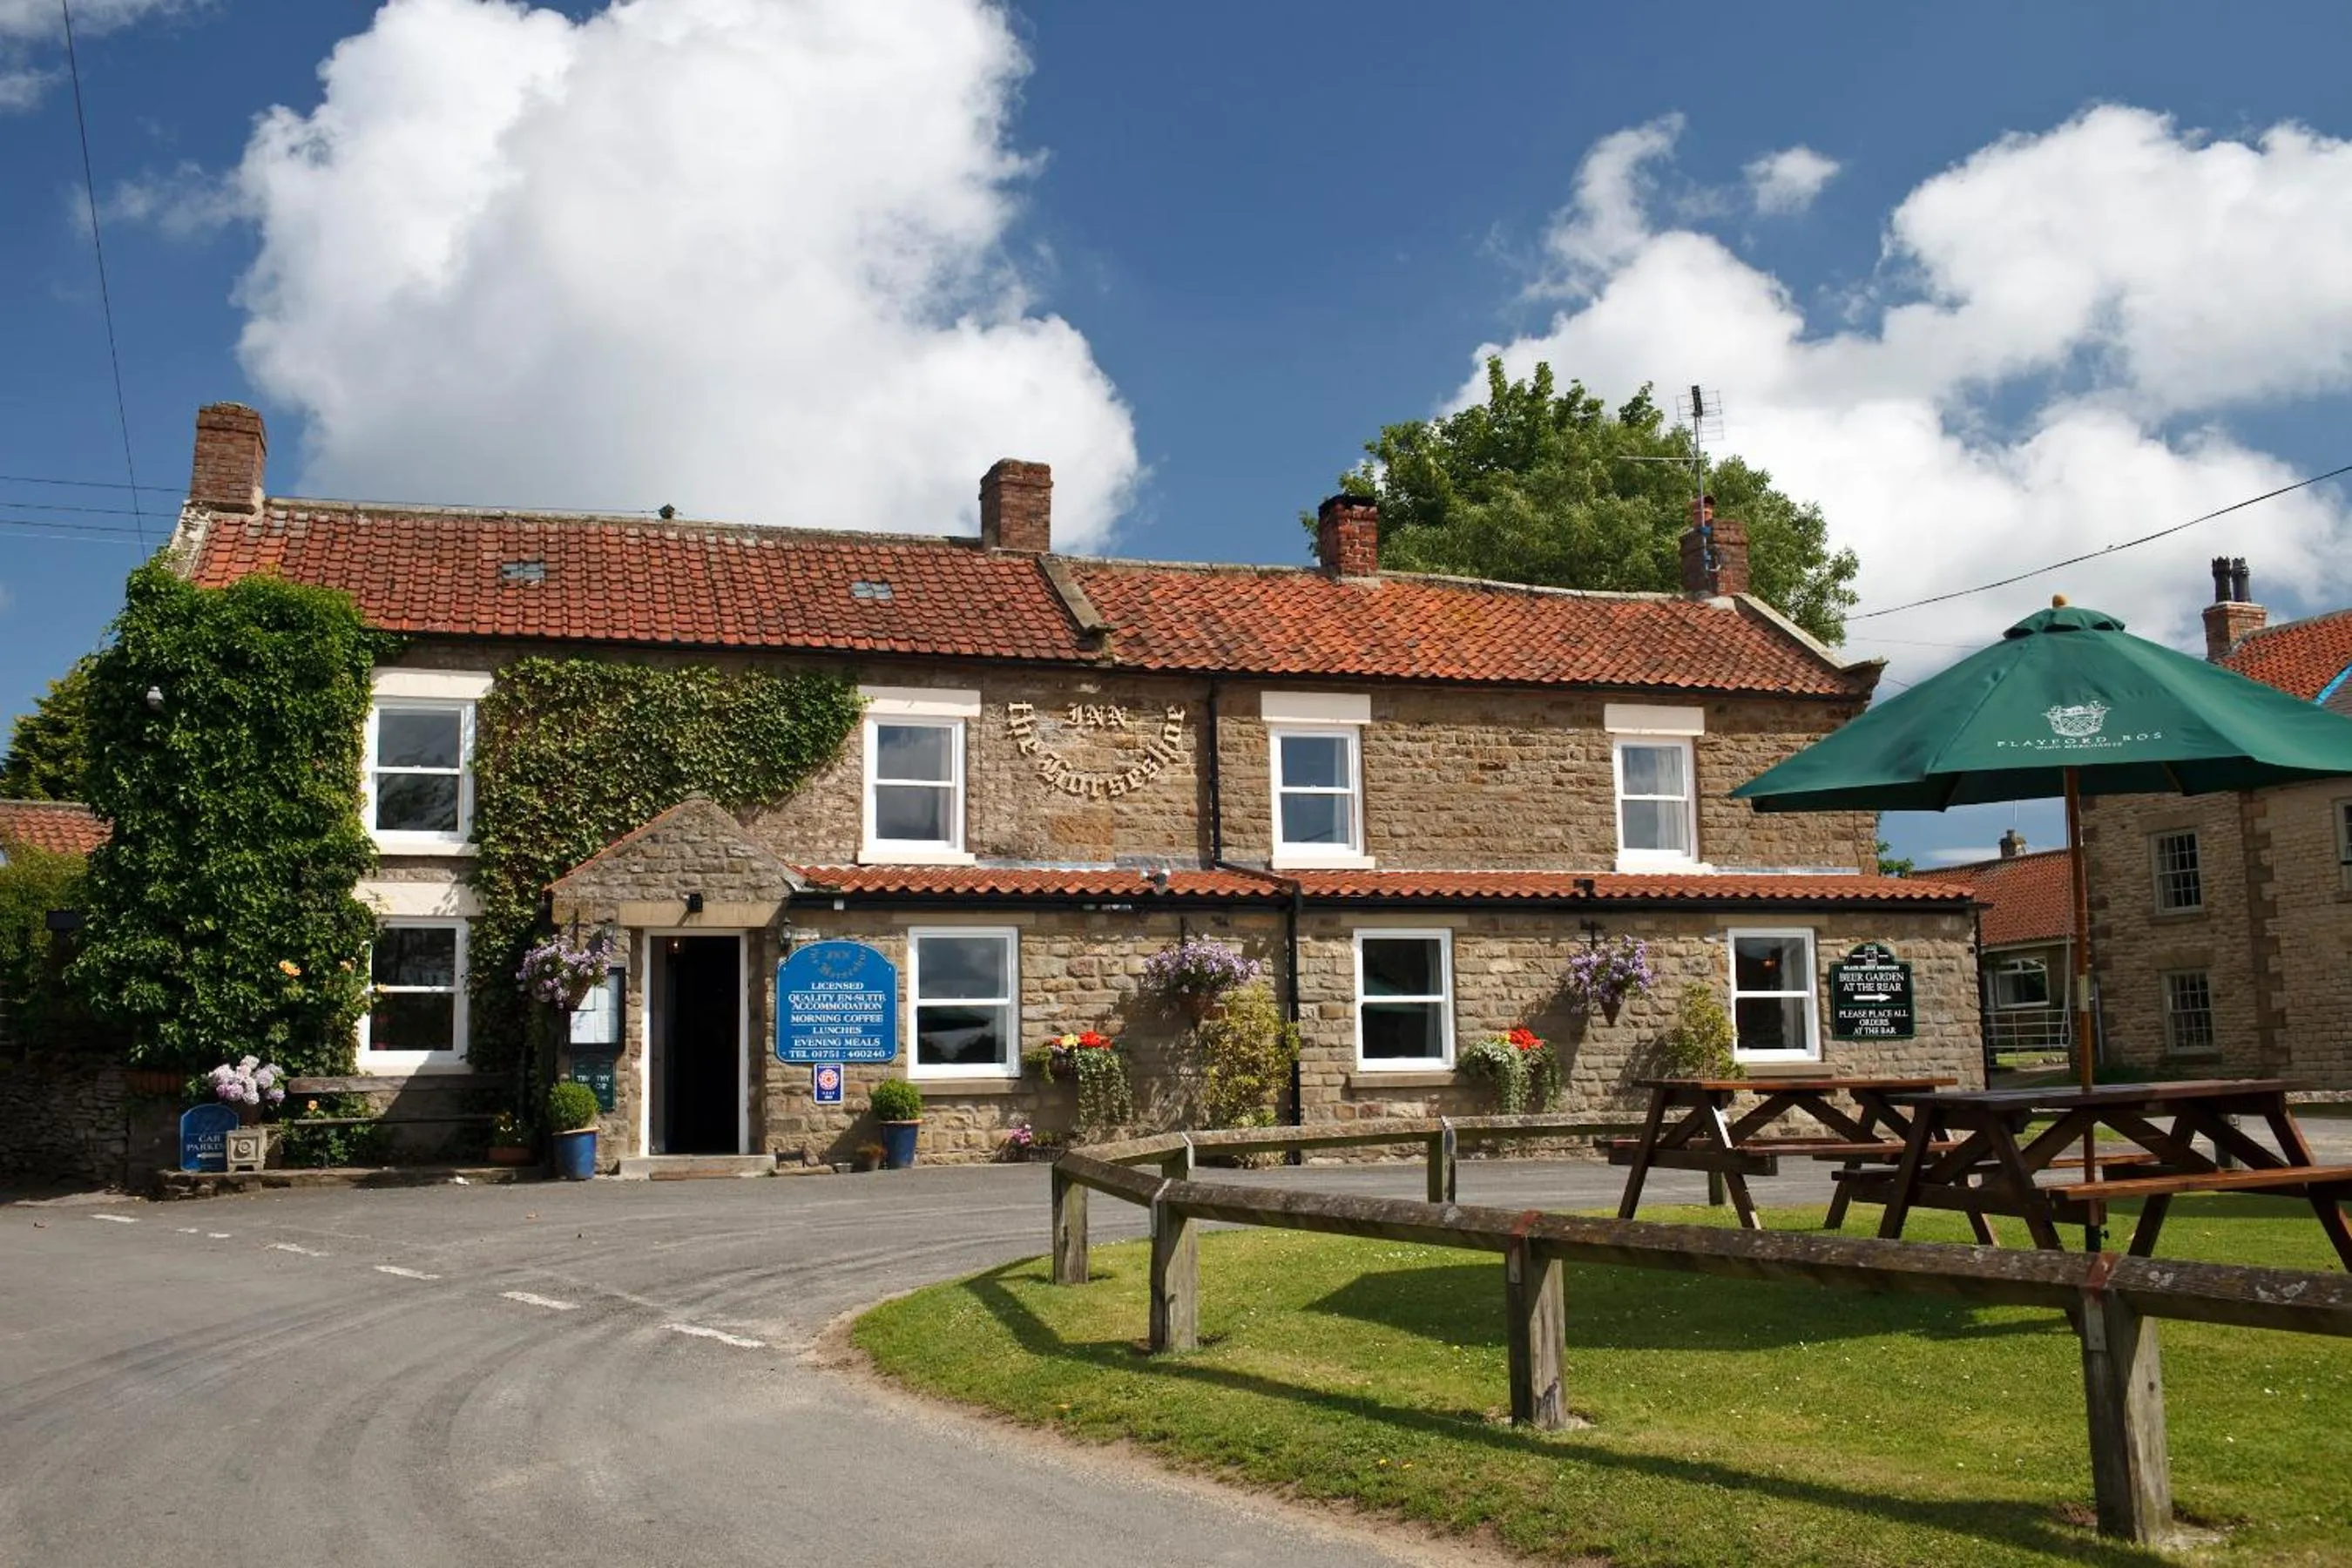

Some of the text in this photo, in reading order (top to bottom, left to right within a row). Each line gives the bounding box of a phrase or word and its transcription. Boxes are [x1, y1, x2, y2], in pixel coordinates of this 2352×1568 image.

[1064, 702, 1128, 727] INN
[1996, 736, 2107, 747] PLAYFORD
[1839, 972, 1904, 982] BEER GARDEN
[811, 982, 864, 990] LICENSED
[1843, 983, 1903, 991] AT THE REAR
[787, 994, 835, 1003] QUALITY
[792, 1002, 882, 1010] ACCOMMODATION
[791, 1013, 883, 1023] MORNING COFFEE
[1839, 1010, 1868, 1018] PLEASE
[1869, 1010, 1893, 1018] PLACE
[844, 1037, 881, 1046] MEALS
